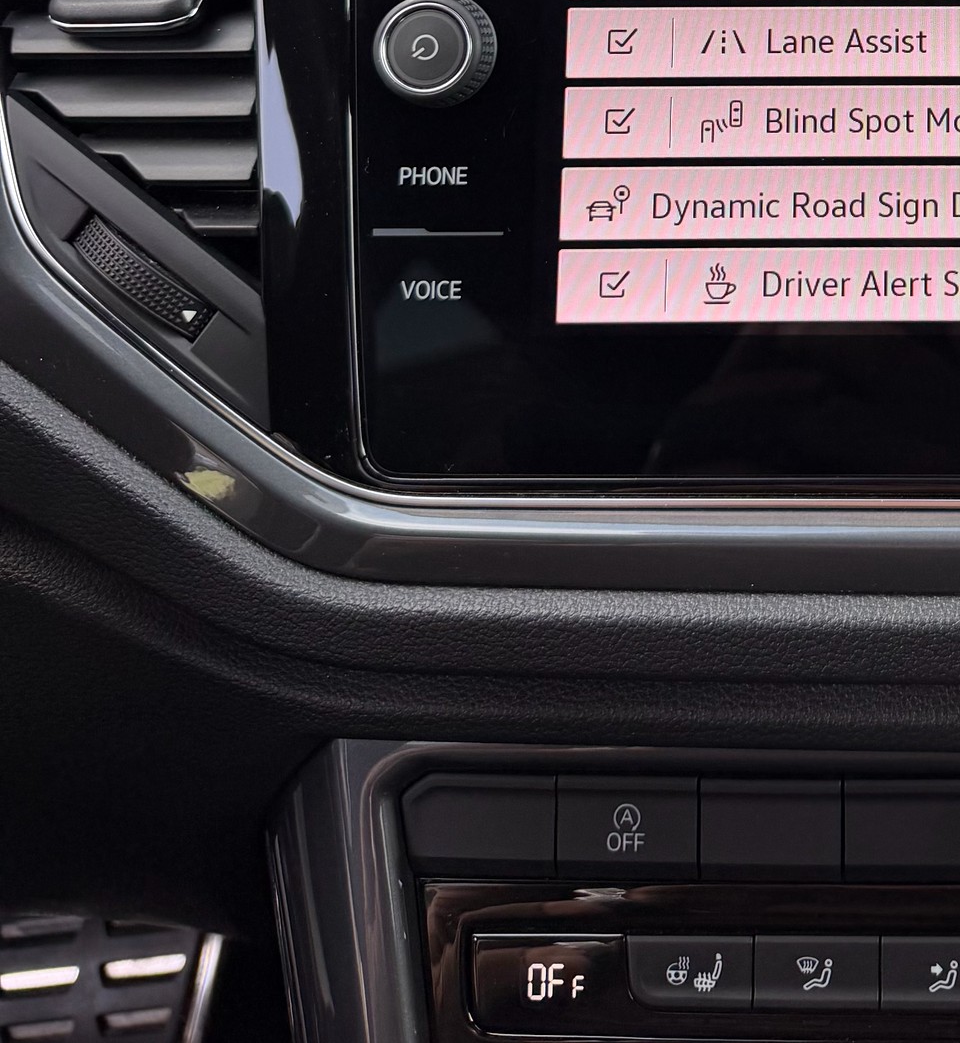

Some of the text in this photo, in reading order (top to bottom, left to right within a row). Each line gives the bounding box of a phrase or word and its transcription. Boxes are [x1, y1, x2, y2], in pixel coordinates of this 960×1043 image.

[767, 28, 928, 54] Lane Assist
[766, 107, 836, 134] Blind
[849, 107, 915, 141] Spot
[399, 166, 469, 186] PHONE
[652, 192, 780, 226] Dynamic
[792, 191, 866, 219] Road
[878, 191, 939, 225] Sign
[401, 280, 462, 300] VOICE
[762, 270, 851, 297] Driver
[861, 270, 932, 297] Alert
[606, 832, 645, 852] OFF
